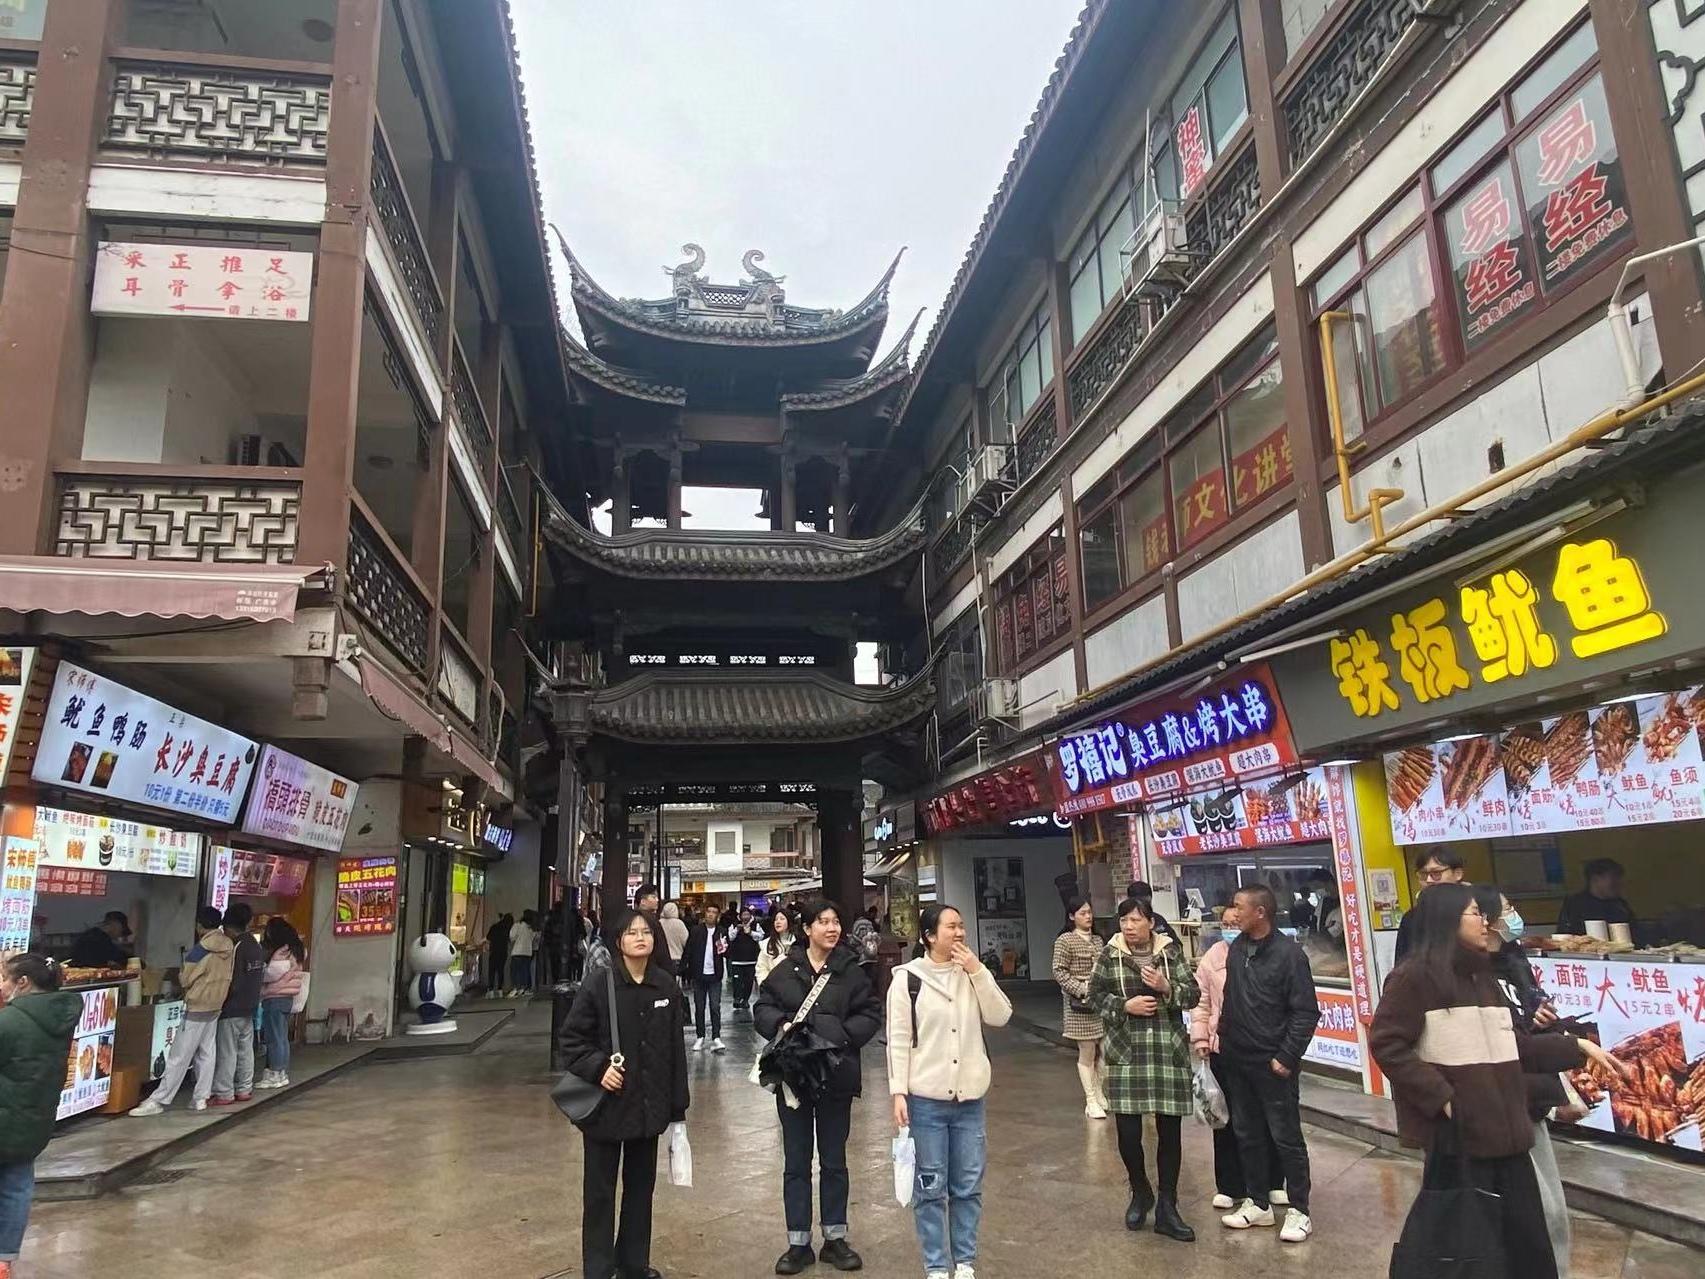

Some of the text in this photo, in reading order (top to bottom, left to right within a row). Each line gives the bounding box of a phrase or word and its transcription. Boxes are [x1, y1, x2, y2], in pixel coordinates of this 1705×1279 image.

[1538, 98, 1613, 253] 易经
[1461, 177, 1522, 314] 易经
[1330, 539, 1669, 718] 铁板鱿鱼
[61, 695, 148, 751] 鱿鱼鸭肠
[154, 732, 241, 796] 长沙臭豆腐
[1669, 766, 1699, 787] 鱼须
[1575, 780, 1601, 798] 鸭肠
[1620, 773, 1650, 791] 鱿鱼
[1481, 798, 1507, 818] 鲜肉
[1530, 789, 1554, 804] 面筋
[1554, 963, 1589, 989] 面筋
[1631, 967, 1672, 995] 鱿鱼
